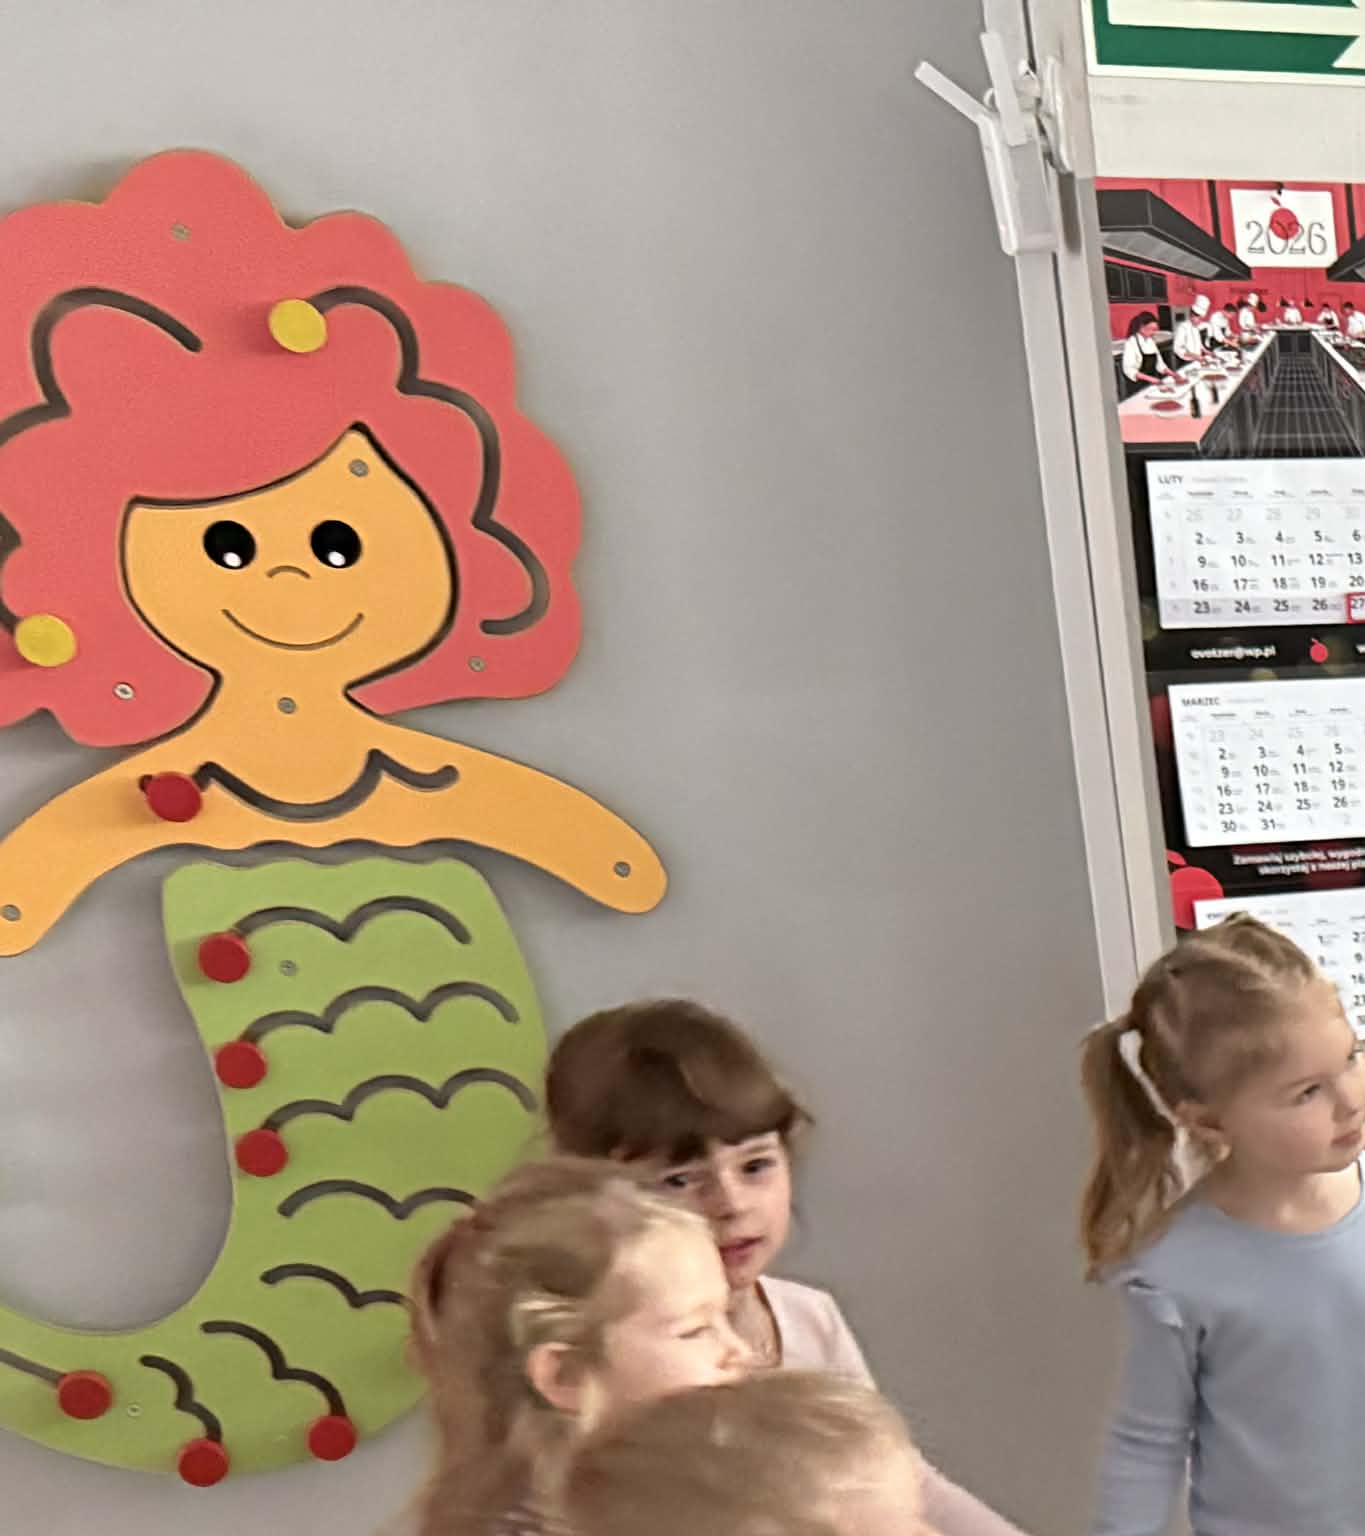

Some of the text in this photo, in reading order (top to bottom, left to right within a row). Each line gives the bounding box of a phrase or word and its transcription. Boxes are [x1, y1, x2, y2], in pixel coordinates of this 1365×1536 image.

[1245, 219, 1328, 257] 2026
[1158, 475, 1183, 485] LUTY
[1195, 532, 1204, 545] 2
[1236, 532, 1245, 544] 3
[1275, 530, 1284, 543] 4
[1314, 530, 1323, 542] 5
[1352, 529, 1361, 542] 6
[1197, 556, 1207, 569] 9
[1231, 554, 1247, 568] 10
[1272, 554, 1285, 566] 11
[1309, 553, 1324, 565] 12
[1348, 552, 1363, 565] 13
[1192, 579, 1209, 591] 16
[1233, 578, 1248, 591] 17
[1272, 577, 1288, 590] 18
[1311, 577, 1326, 589] 19
[1349, 575, 1365, 587] 20
[1193, 601, 1210, 614] 23
[1234, 600, 1251, 613] 24
[1273, 599, 1289, 612] 25
[1312, 598, 1328, 611] 26
[1351, 597, 1365, 609] 27
[1218, 747, 1227, 760] 2
[1258, 746, 1266, 759] 3
[1296, 744, 1304, 756] 4
[1334, 742, 1343, 754] 5
[1221, 766, 1230, 778] 9
[1253, 764, 1269, 776] 10
[1293, 762, 1307, 775] 11
[1329, 760, 1344, 773] 12
[1217, 784, 1232, 797] 16
[1256, 782, 1270, 795] 17
[1293, 781, 1309, 793] 18
[1331, 778, 1346, 791] 19
[1218, 802, 1234, 815] 23
[1257, 800, 1273, 813] 24
[1296, 798, 1311, 810] 25
[1333, 796, 1348, 808] 26
[1221, 818, 1276, 832] 30 31
[1353, 932, 1360, 943] 2
[1355, 953, 1363, 964] 9
[1352, 973, 1365, 984] 16
